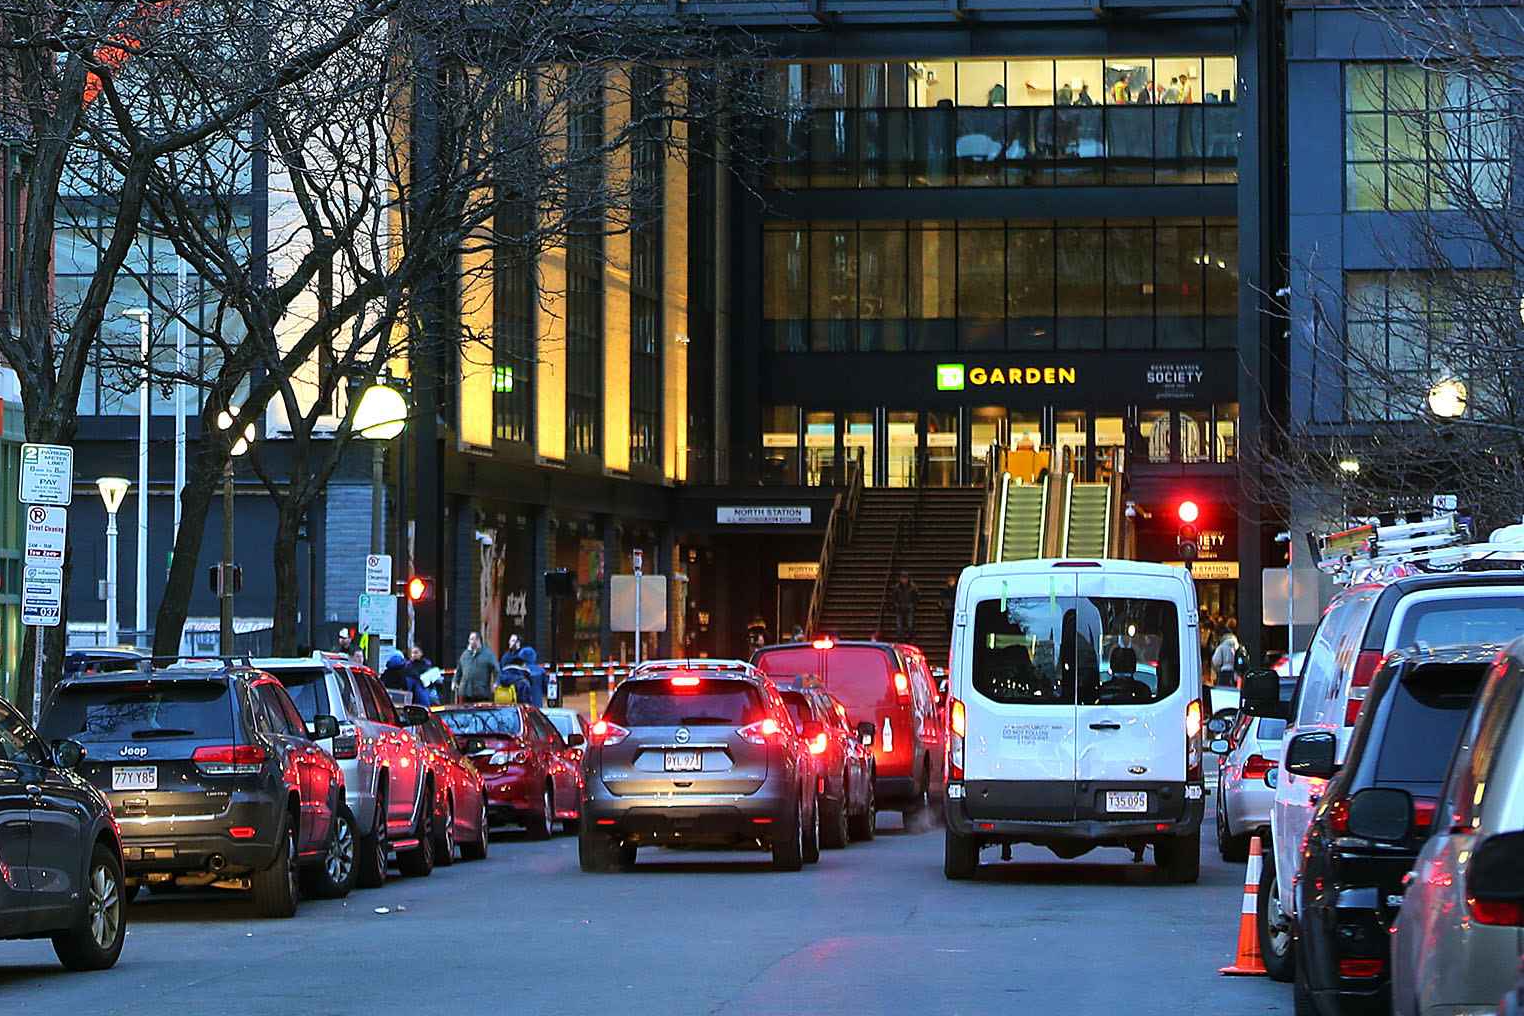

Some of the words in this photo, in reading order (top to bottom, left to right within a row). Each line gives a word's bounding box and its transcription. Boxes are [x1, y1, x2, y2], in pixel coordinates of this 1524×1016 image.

[969, 367, 1076, 385] GARDEN
[1147, 371, 1204, 383] SOCIETY
[26, 447, 38, 459] 2
[734, 509, 764, 517] NORTH
[766, 509, 802, 517] STATION
[44, 525, 64, 534] Cleaning
[39, 608, 58, 617] 037
[119, 746, 148, 757] Jeep
[666, 755, 681, 766] 9YL
[684, 755, 700, 766] 971
[115, 772, 133, 784] 77Y
[136, 772, 155, 783] Y85
[1127, 796, 1145, 807] 095
